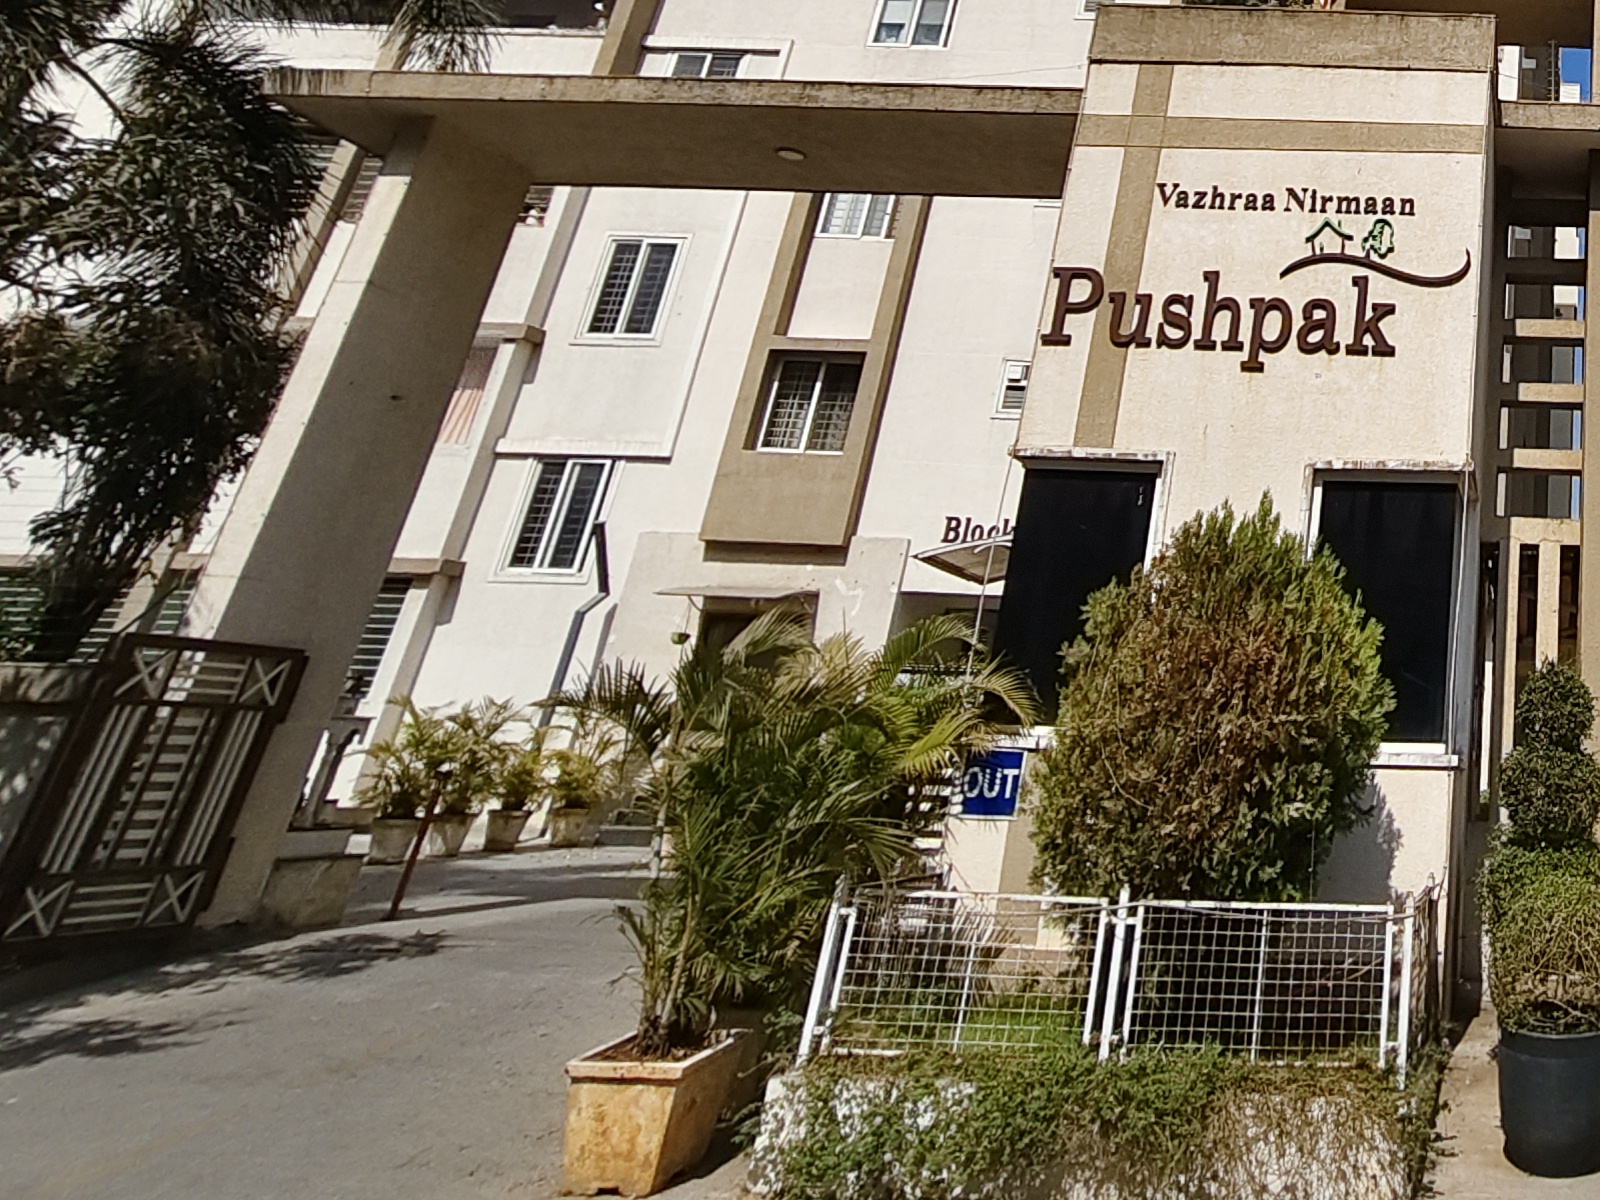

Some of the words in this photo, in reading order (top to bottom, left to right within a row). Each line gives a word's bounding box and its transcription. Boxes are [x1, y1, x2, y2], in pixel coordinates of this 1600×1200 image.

[1156, 183, 1276, 212] Vazhraa
[1284, 187, 1416, 217] Nirmaan
[1041, 266, 1397, 373] Pushpak
[963, 767, 1020, 799] OUT
